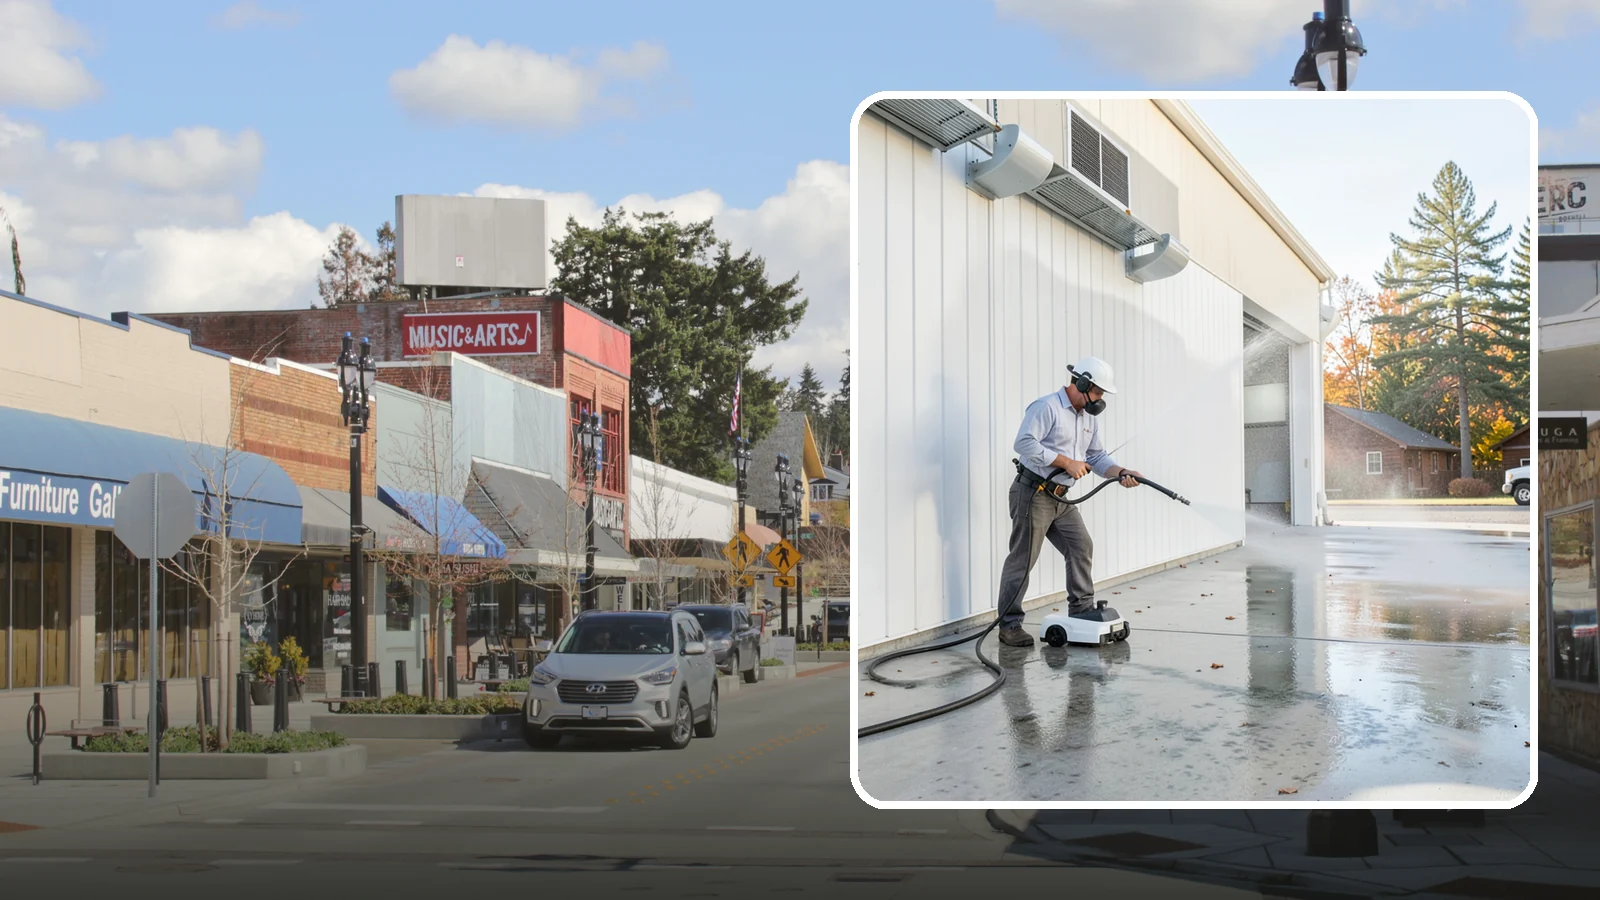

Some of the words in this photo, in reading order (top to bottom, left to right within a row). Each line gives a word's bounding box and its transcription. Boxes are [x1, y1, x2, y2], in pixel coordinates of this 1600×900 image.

[0, 471, 79, 515] Furniture
[89, 482, 122, 519] Gal
[453, 563, 480, 575] SUSHI
